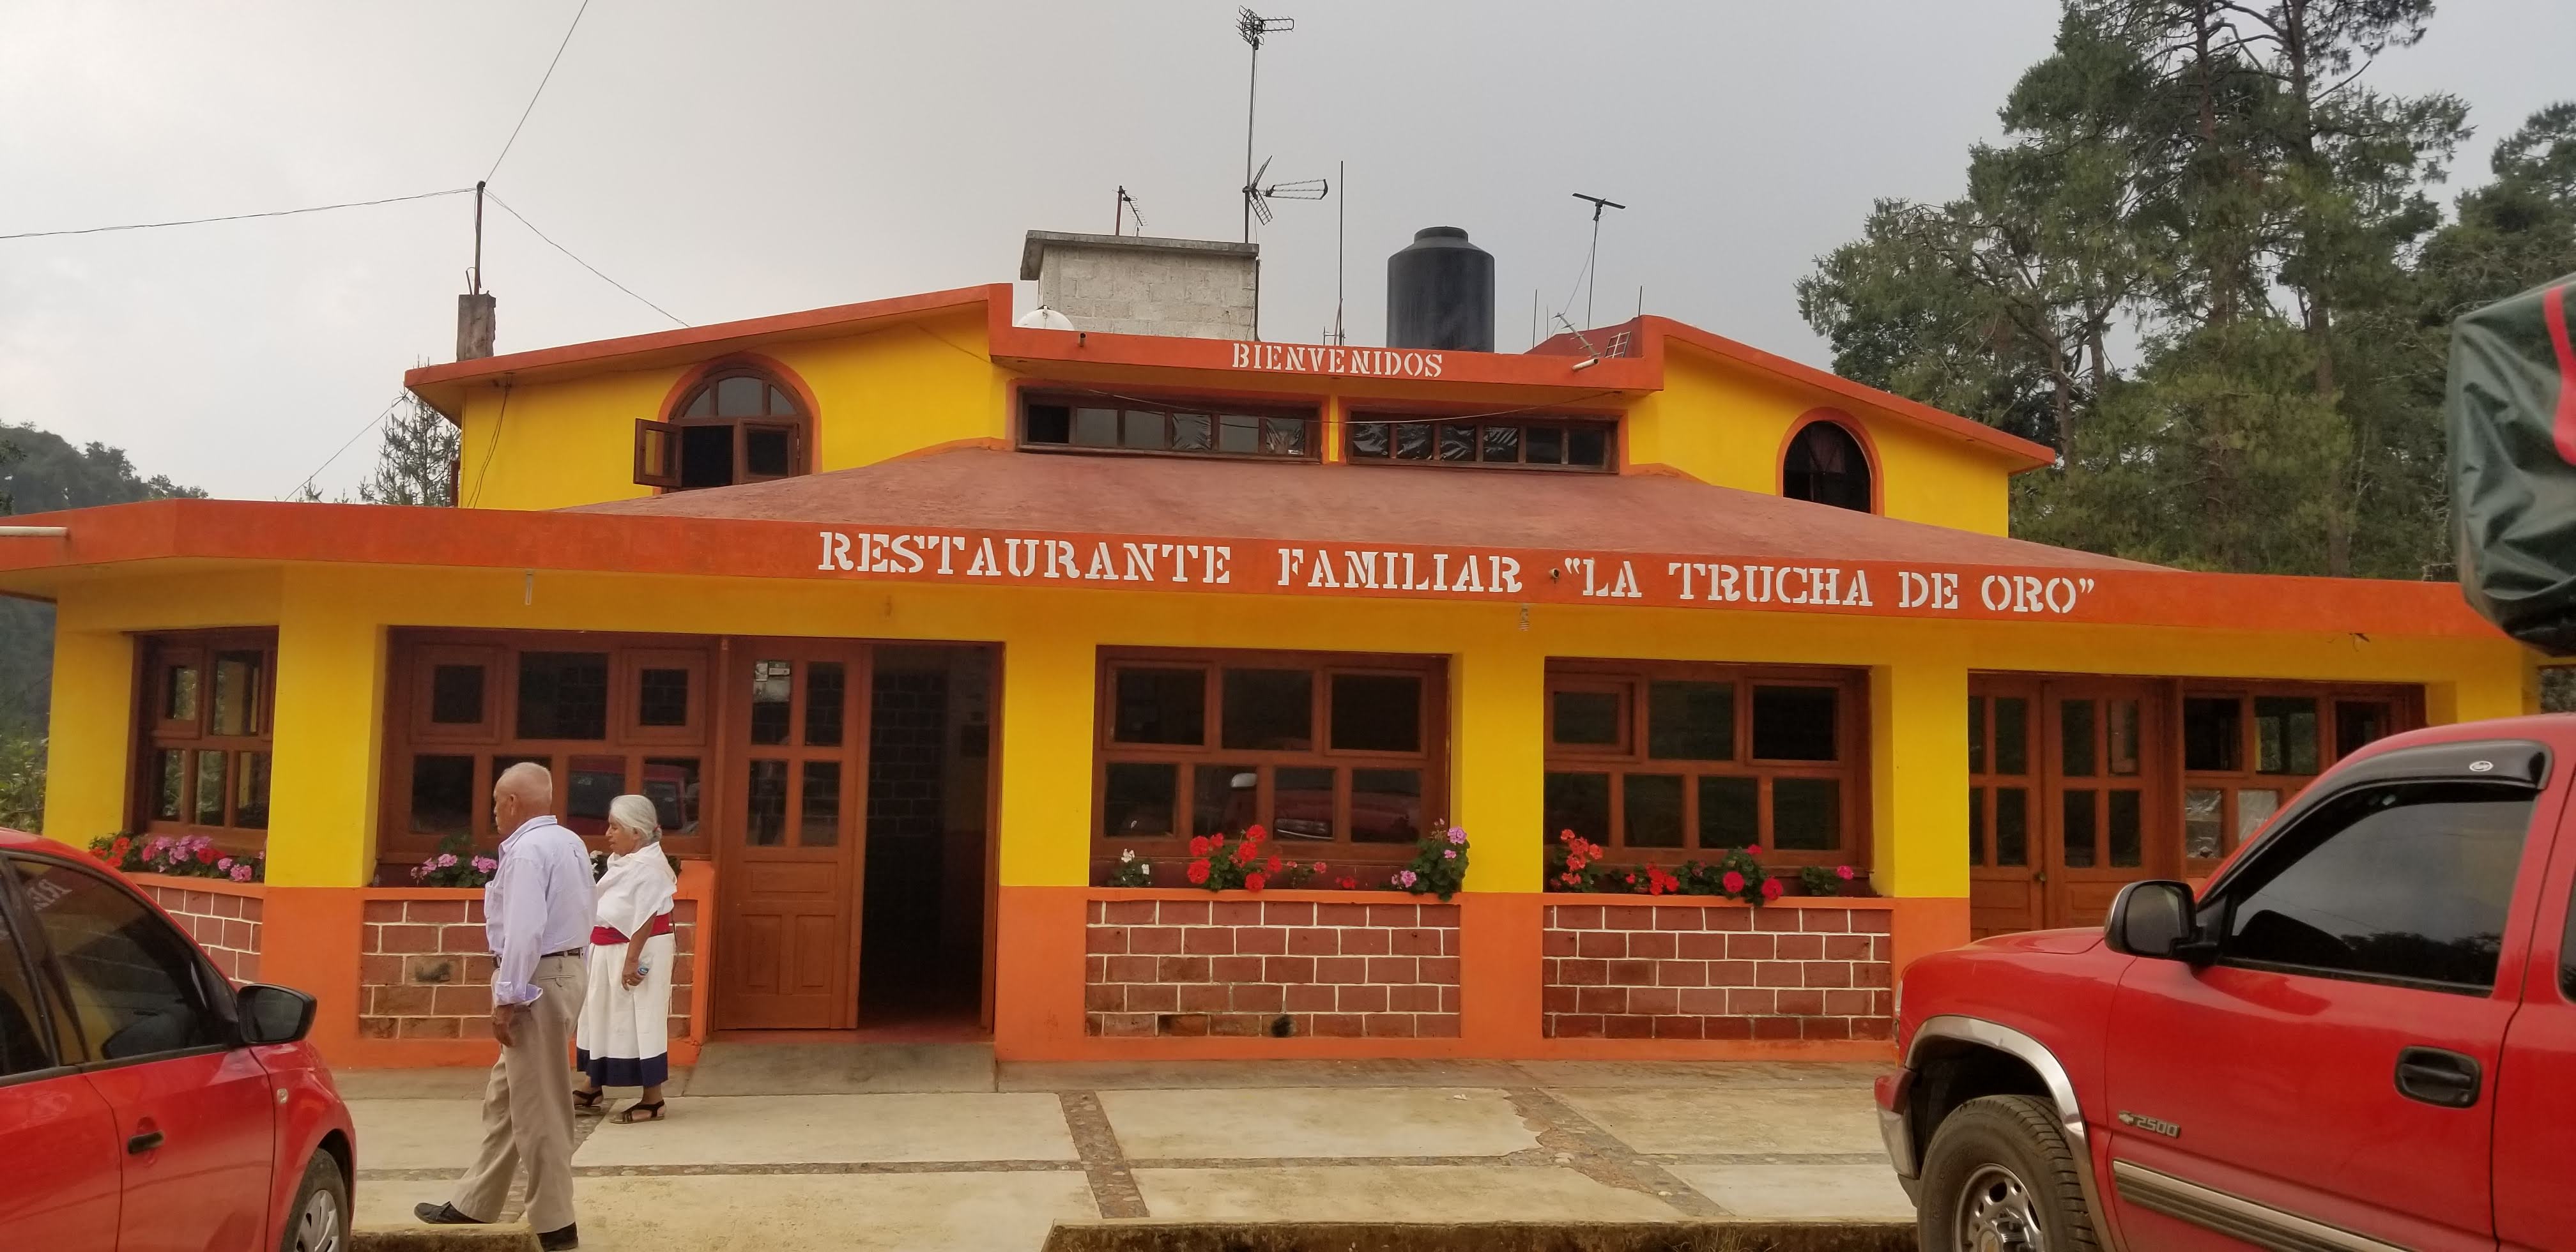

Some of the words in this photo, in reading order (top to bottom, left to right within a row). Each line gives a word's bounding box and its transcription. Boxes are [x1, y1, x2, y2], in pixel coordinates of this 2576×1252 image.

[1232, 342, 1443, 378] BIENVENIDOS
[818, 531, 1230, 584] RESTAURANTE
[1278, 548, 1523, 593] FAMILIAR
[1668, 562, 1873, 607] TRUCHA
[1898, 571, 1959, 609] DE
[2136, 1116, 2179, 1138] 2500
